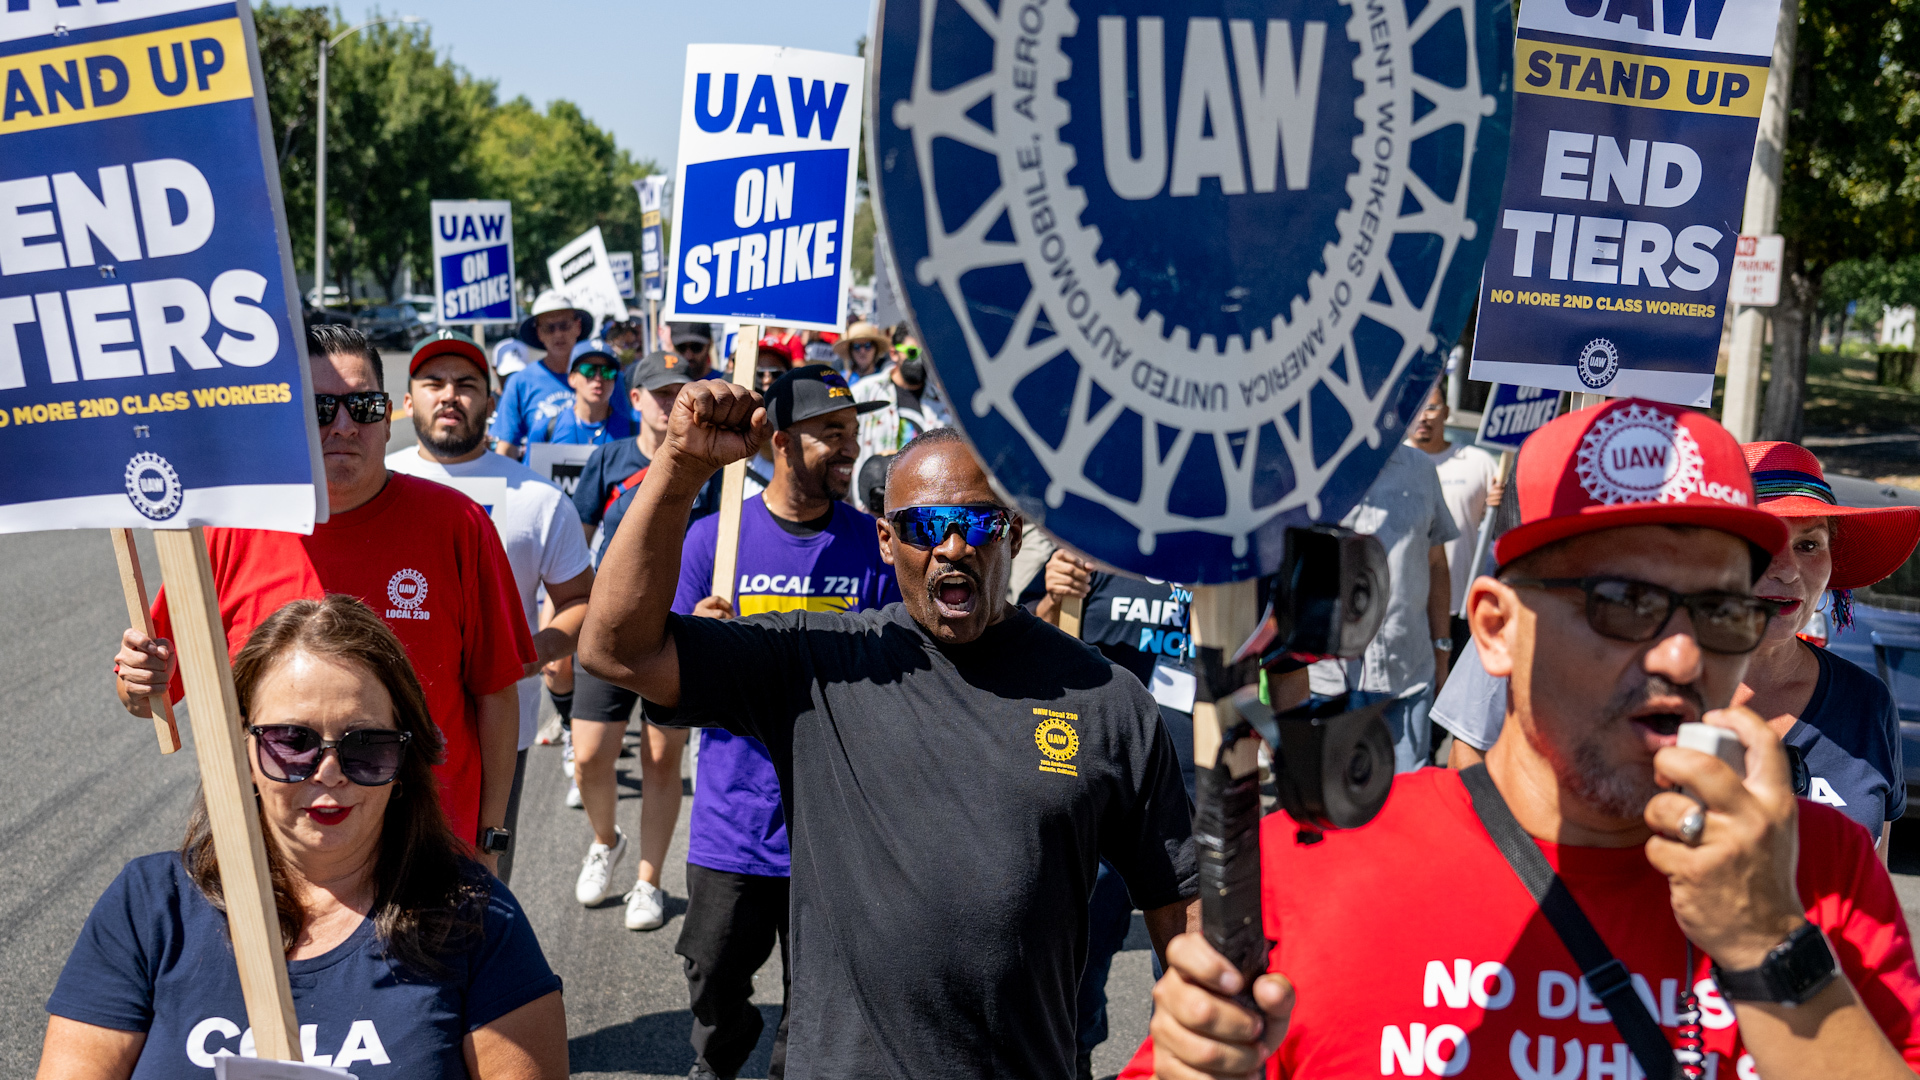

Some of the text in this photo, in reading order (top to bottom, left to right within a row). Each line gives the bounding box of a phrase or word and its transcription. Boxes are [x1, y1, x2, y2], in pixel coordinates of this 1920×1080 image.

[3, 37, 225, 121] AND UP
[1012, 0, 1045, 122] AERO
[1525, 50, 1750, 107] STAND UP
[694, 73, 850, 141] UAW
[1097, 16, 1328, 200] UAW
[734, 162, 795, 229] ON
[1541, 130, 1702, 208] END
[0, 159, 216, 276] END
[439, 214, 504, 241] UAW
[1238, 0, 1395, 408] MENT WORKERS OF AMERICA
[461, 250, 489, 284] ON
[683, 219, 837, 305] STRIKE
[1502, 209, 1724, 291] TIERS
[445, 273, 509, 318] STRIKE
[1491, 289, 1716, 318] NO MORE 2ND CLASS WORKERS
[0, 269, 280, 391] TIERS
[1131, 359, 1228, 412] UNITED
[1589, 356, 1607, 368] UAW
[14, 401, 78, 426] MORE
[79, 397, 120, 419] 2ND
[121, 391, 191, 415] CLASS
[192, 383, 292, 408] WORKERS
[1486, 398, 1556, 438] STRIKE
[1612, 446, 1667, 470] UAW
[399, 583, 417, 594] UAW
[738, 574, 861, 595] LOCAL 721
[386, 609, 430, 620] LOCAL 230
[1139, 627, 1196, 658] NO
[1032, 707, 1048, 716] UAW
[1048, 709, 1066, 719] Local
[1047, 733, 1067, 745] UAW
[1422, 958, 1516, 1011] NO
[186, 1016, 392, 1069] CLA
[1379, 1022, 1471, 1078] NO
